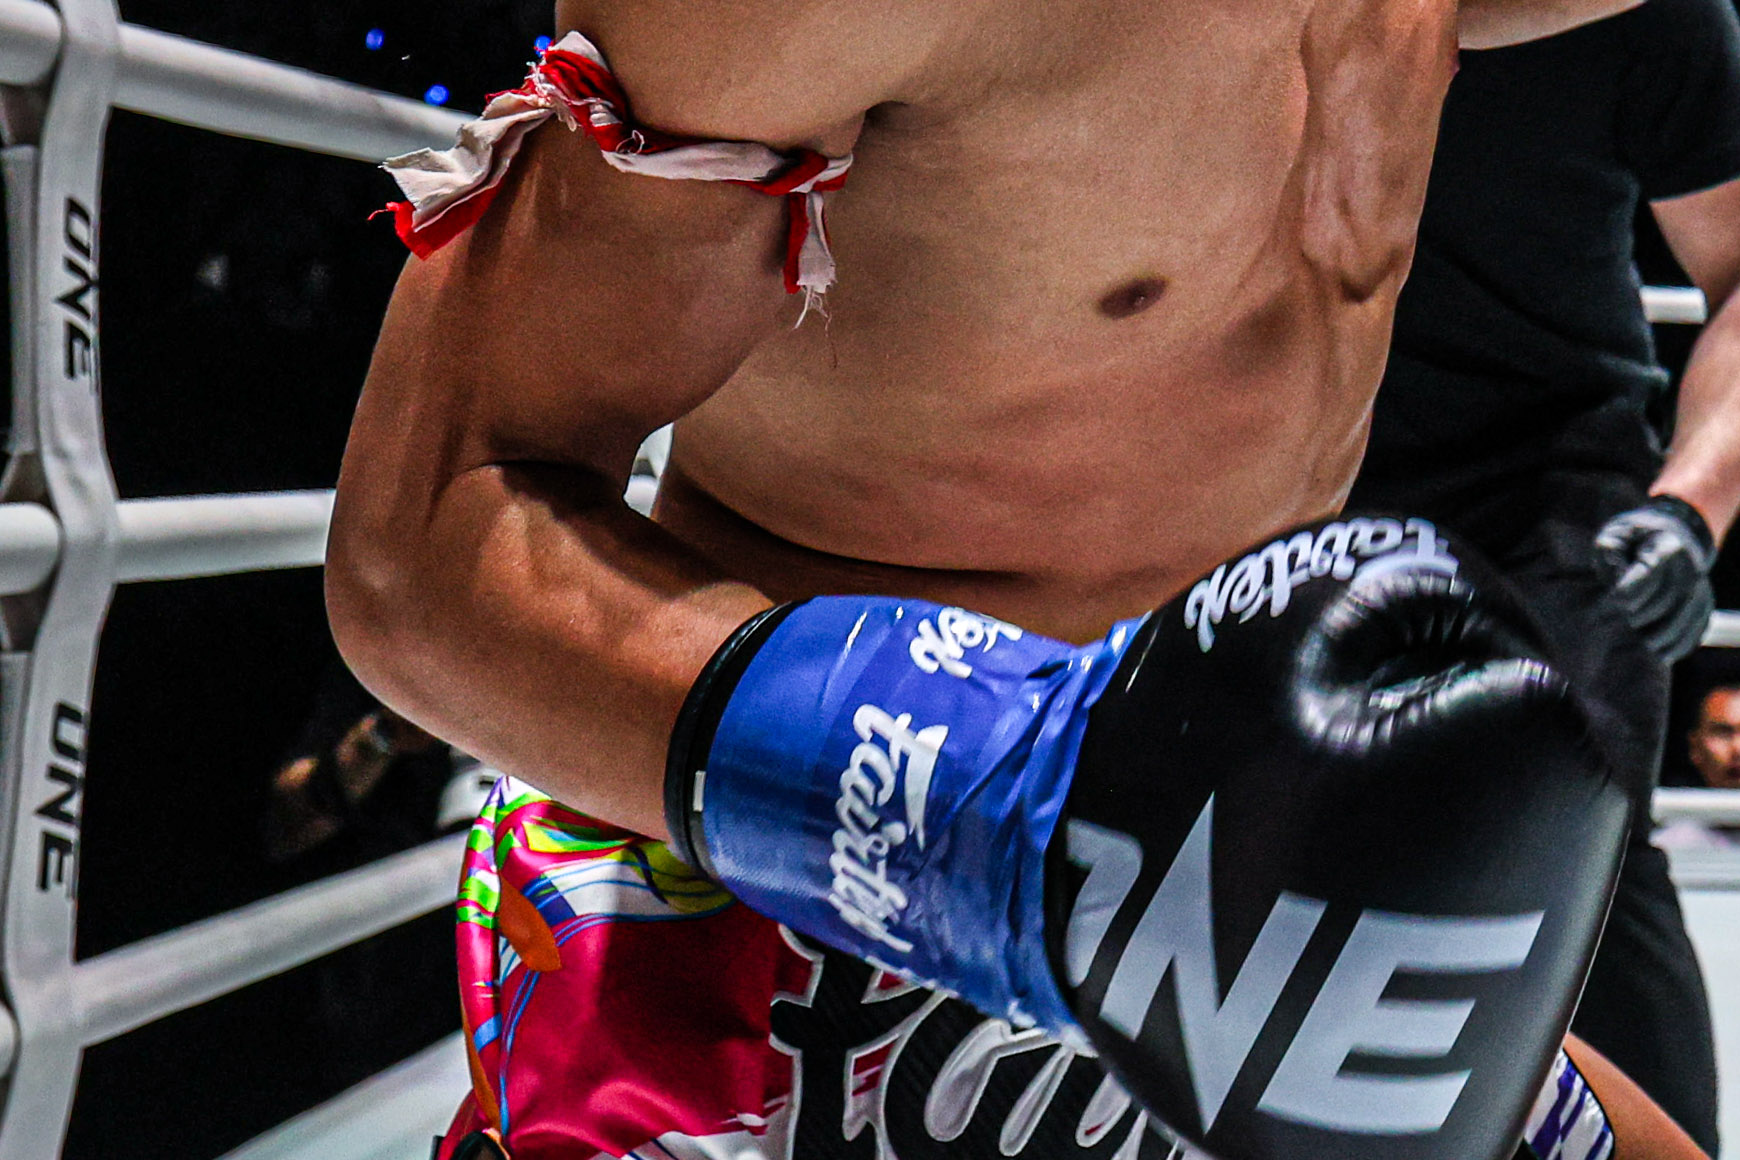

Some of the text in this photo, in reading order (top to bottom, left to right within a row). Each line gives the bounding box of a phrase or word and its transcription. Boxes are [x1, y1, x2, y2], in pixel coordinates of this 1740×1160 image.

[53, 197, 100, 395] ONE
[1184, 517, 1459, 653] Fairtex
[33, 702, 90, 902] ONE
